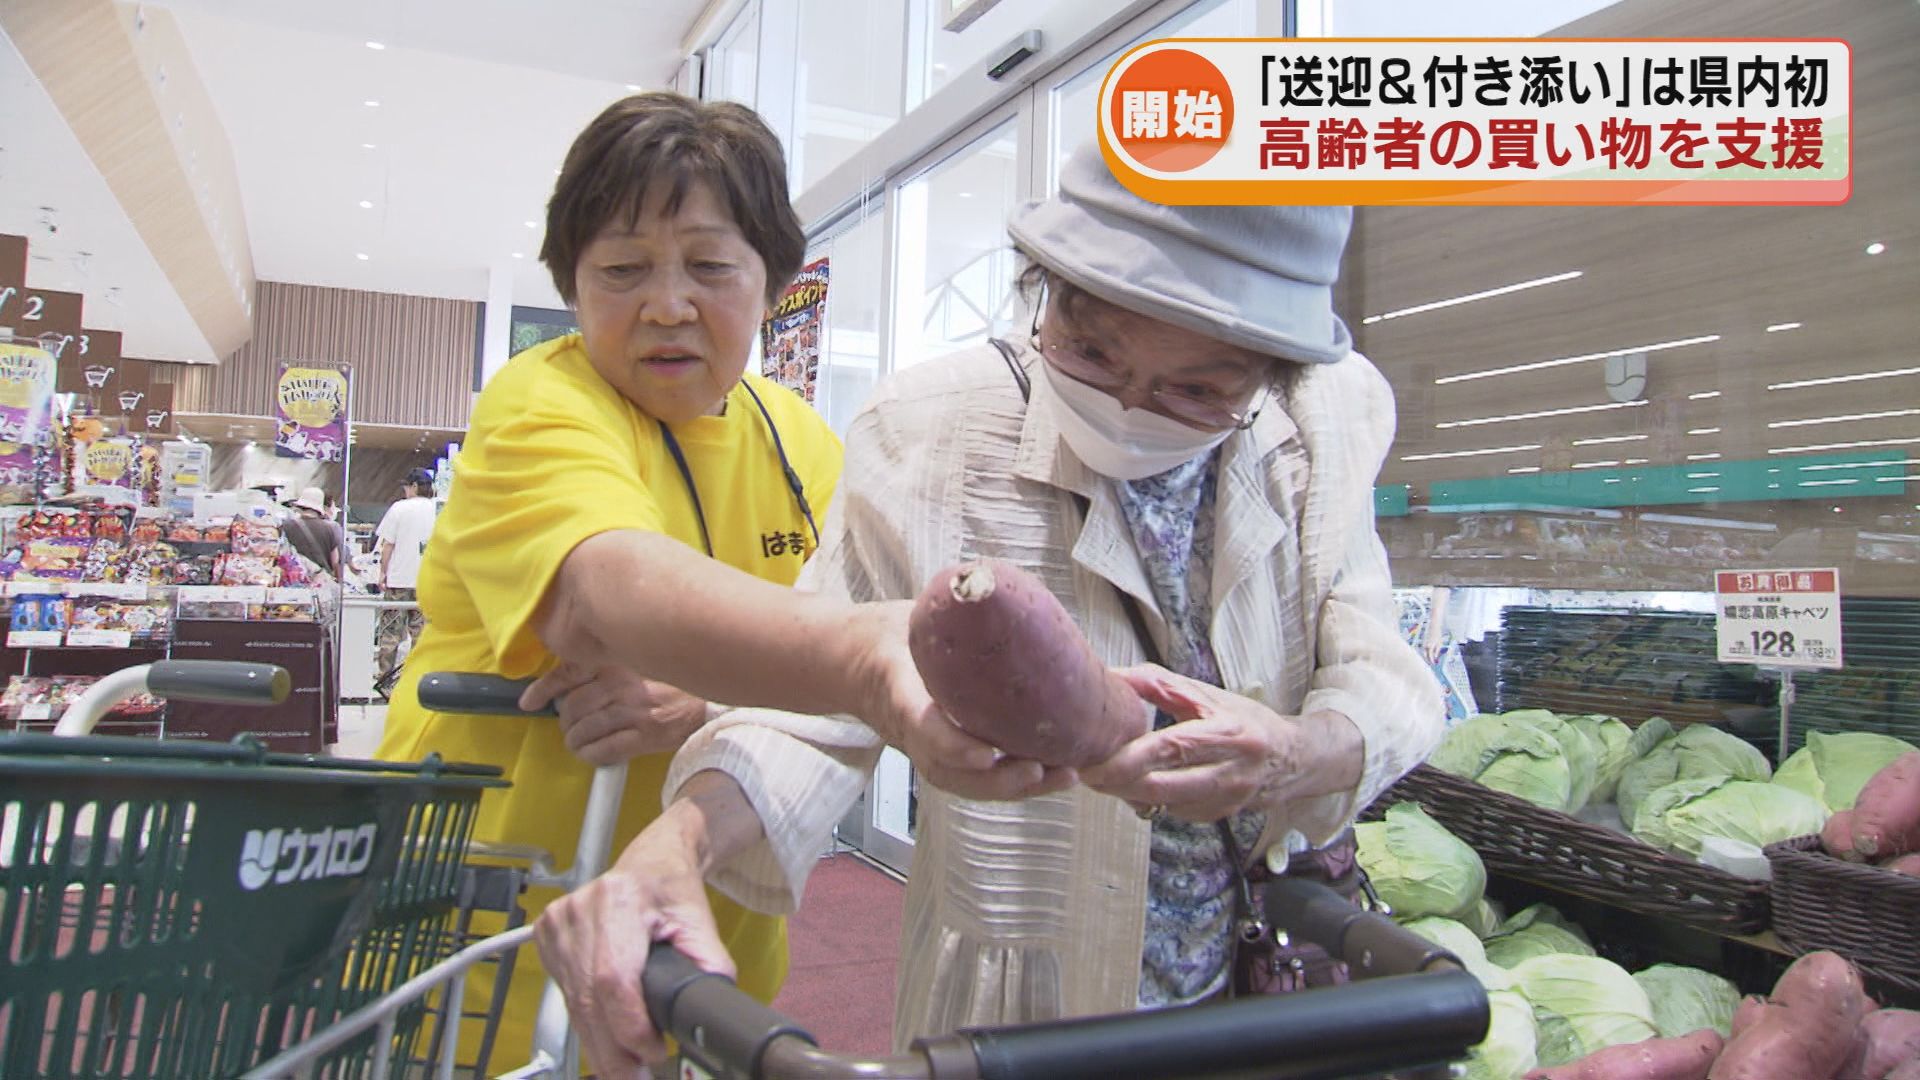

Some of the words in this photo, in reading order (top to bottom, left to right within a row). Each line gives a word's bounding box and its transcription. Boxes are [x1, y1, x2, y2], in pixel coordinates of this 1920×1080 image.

[22, 296, 44, 320] 2
[79, 335, 90, 355] 3
[1751, 631, 1795, 657] 128
